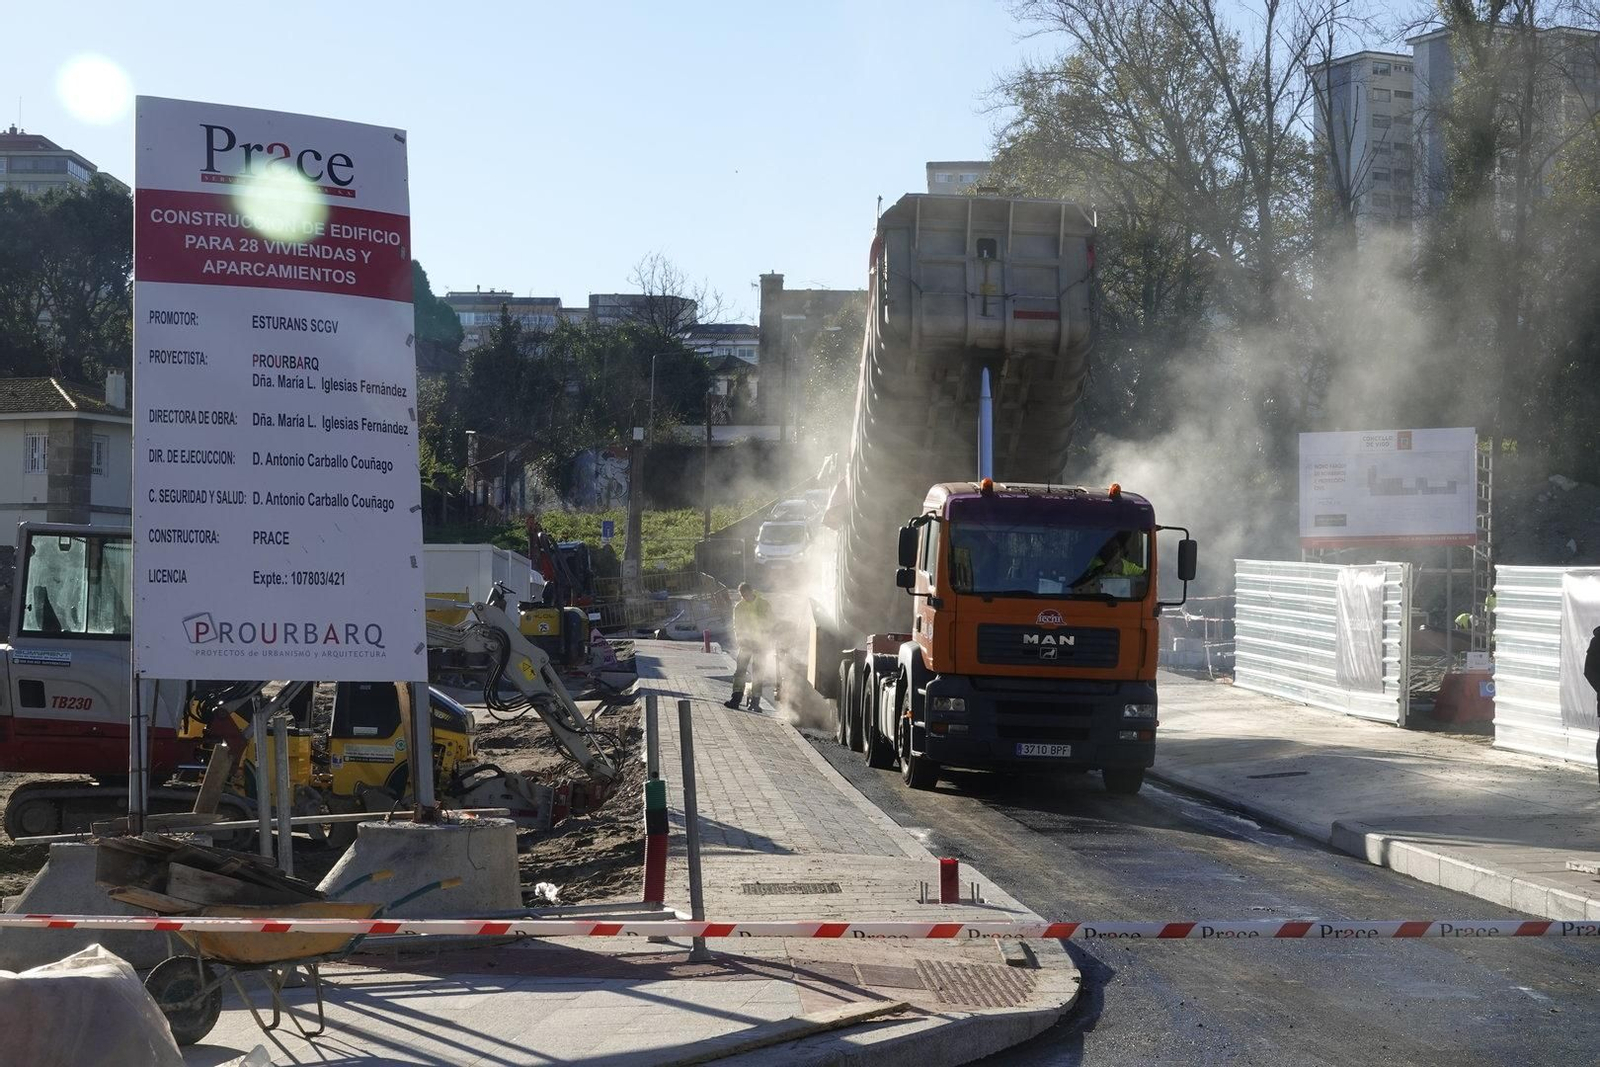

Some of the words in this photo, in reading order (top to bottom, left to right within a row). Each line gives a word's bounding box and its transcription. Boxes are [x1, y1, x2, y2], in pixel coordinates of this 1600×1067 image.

[200, 124, 354, 186] Prace
[304, 219, 324, 237] DE
[331, 224, 400, 246] EDIFICIO
[185, 234, 234, 252] PARA
[239, 238, 259, 253] 28
[263, 241, 357, 262] VIVIENDAS
[358, 251, 371, 264] Y
[202, 259, 357, 285] APARCAMIENTOS
[149, 310, 199, 326] PROMOTOR:
[252, 315, 307, 331] ESTURANS
[310, 320, 338, 334] SCGV
[149, 350, 208, 365] PROYECTISTA:
[252, 354, 319, 371] PROURBARQ
[252, 374, 274, 388] Dña.
[277, 374, 305, 389] María
[307, 377, 316, 389] L.
[322, 377, 357, 393] Iglesias
[360, 379, 407, 398] Fernández
[149, 409, 197, 424] DIRECTORA
[198, 410, 210, 424] DE
[211, 411, 237, 425] OBRA:
[252, 413, 274, 427] Dña.
[277, 413, 305, 428] María
[307, 415, 316, 428] L.
[322, 415, 359, 432] Iglesias
[361, 417, 408, 435] Fernández
[149, 449, 165, 463] DIR.
[167, 450, 179, 463] DE
[180, 450, 236, 465] EJECUCCION:
[253, 452, 263, 466] D.
[266, 452, 305, 467] Antonio
[307, 453, 348, 468] Carballo
[351, 454, 393, 474] Couñago
[148, 489, 156, 503] C.
[158, 489, 207, 504] SEGURIDAD
[209, 490, 216, 504] Y
[216, 491, 247, 505] SALUD:
[253, 492, 263, 505] D.
[266, 492, 305, 506] Antonio
[307, 492, 349, 507] Carballo
[351, 494, 394, 513] Couñago
[148, 529, 220, 544] CONSTRUCTORA:
[253, 531, 290, 545] PRACE
[148, 569, 187, 583] LICENCIA
[253, 571, 288, 587] Expte.:
[291, 572, 345, 586] 107803/421
[195, 621, 385, 649] PROURBARQ
[1023, 634, 1075, 647] MAN
[262, 650, 311, 658] URBANISMO
[321, 650, 387, 658] ARQUITECTURA
[52, 695, 93, 711] TB230
[1024, 745, 1047, 755] 3710
[1051, 745, 1068, 755] BPF
[1319, 924, 1379, 938] Prace
[1440, 923, 1499, 937] Prace
[1561, 922, 1600, 936] Pra
